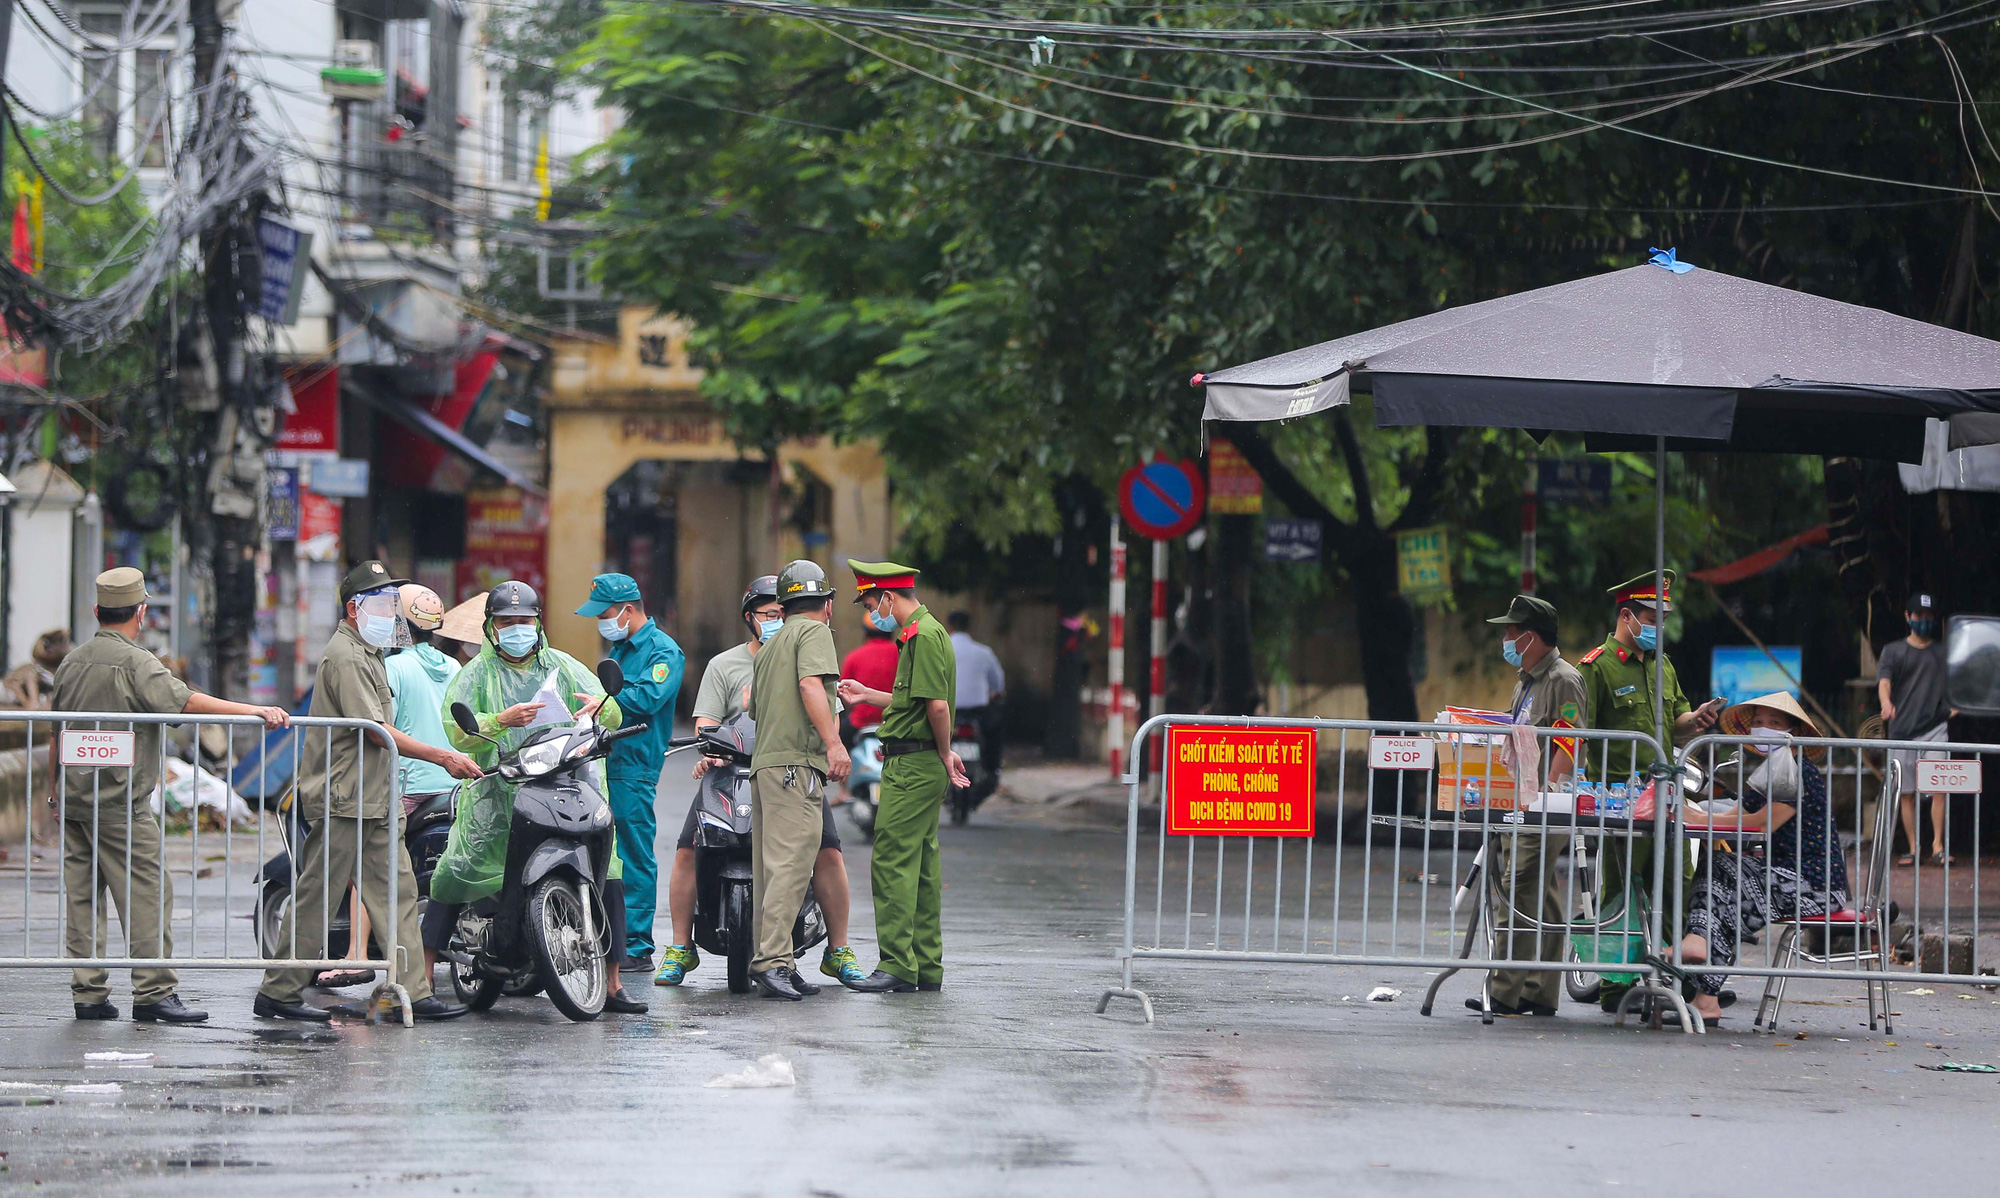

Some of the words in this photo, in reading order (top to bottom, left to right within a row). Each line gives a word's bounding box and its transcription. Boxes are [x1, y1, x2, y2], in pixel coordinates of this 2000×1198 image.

[76, 746, 120, 759] STOP
[1180, 737, 1207, 763] CHỐT
[1208, 736, 1235, 763] KIỂM
[1237, 740, 1265, 764] SOÁT
[1281, 745, 1289, 764] Y
[1290, 739, 1304, 764] TẾ
[1383, 751, 1421, 763] STOP
[1202, 768, 1241, 795] PHÒNG,
[1243, 767, 1279, 793] CHỐNG
[1930, 774, 1968, 786] STOP
[1189, 801, 1214, 825] DỊCH
[1216, 797, 1244, 825] BỆNH
[1246, 802, 1276, 821] COVID
[1279, 802, 1292, 821] 19
